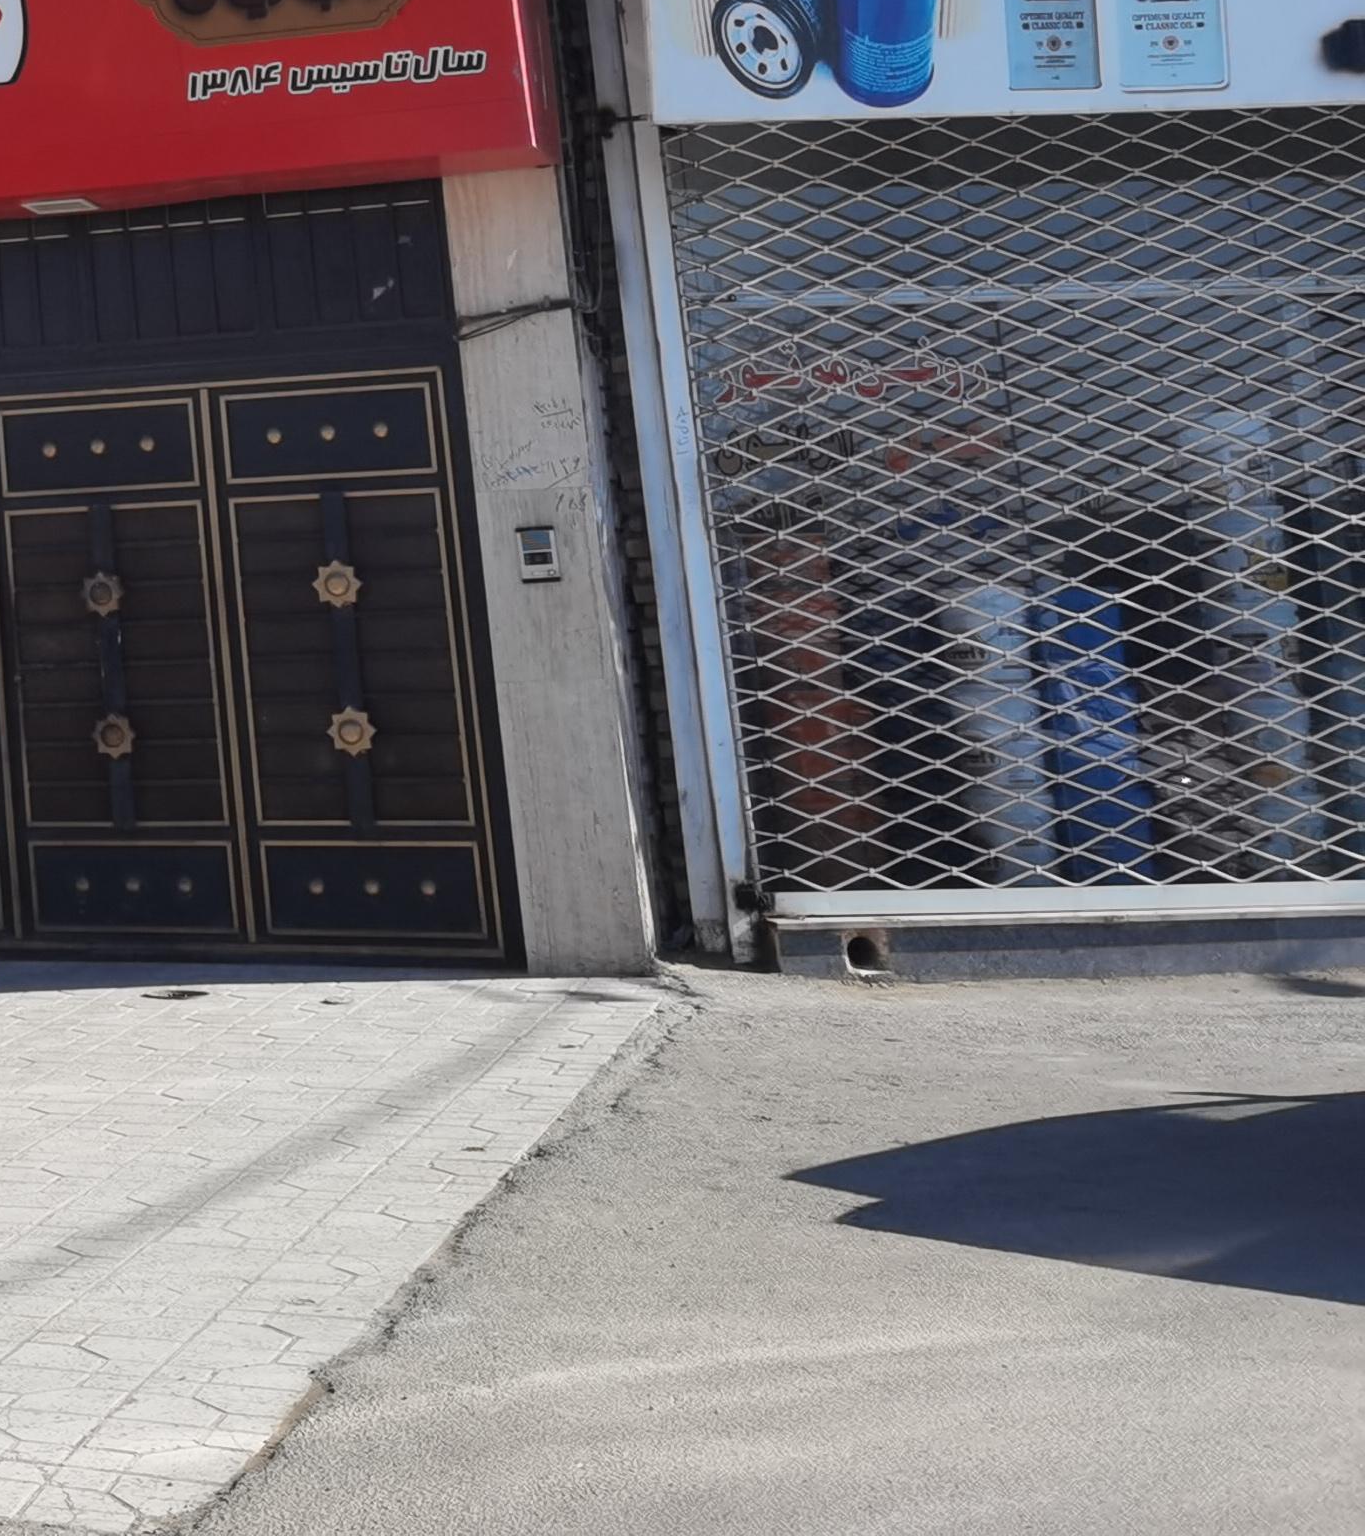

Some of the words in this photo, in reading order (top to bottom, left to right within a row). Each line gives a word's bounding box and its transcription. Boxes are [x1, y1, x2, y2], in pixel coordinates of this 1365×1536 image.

[187, 63, 282, 102] ۱۳۸۴
[288, 50, 413, 94] تاسیس
[410, 46, 486, 83] سال
